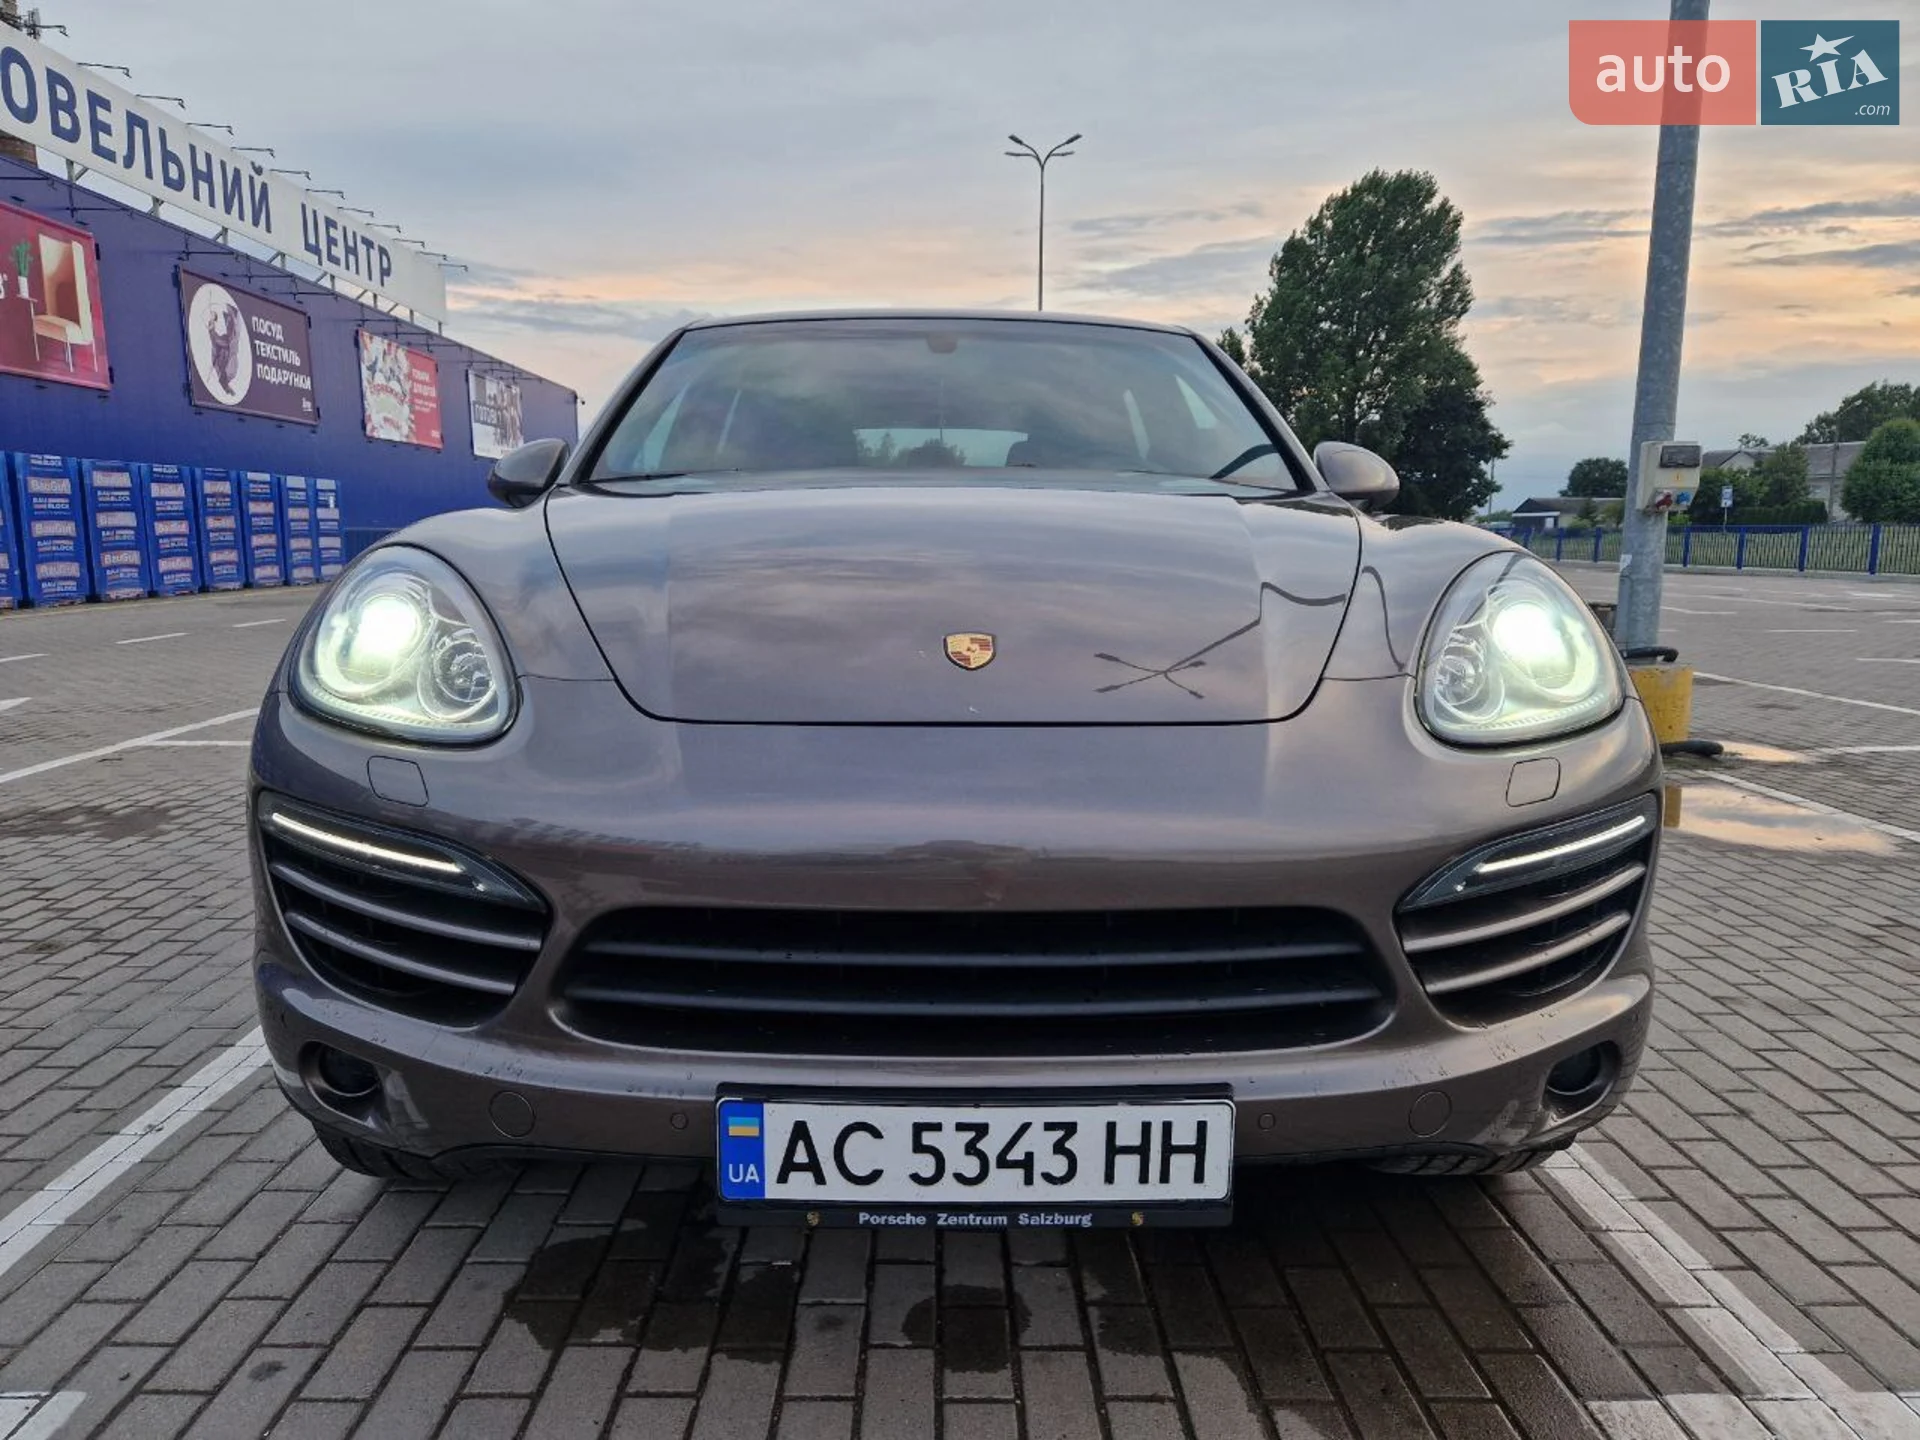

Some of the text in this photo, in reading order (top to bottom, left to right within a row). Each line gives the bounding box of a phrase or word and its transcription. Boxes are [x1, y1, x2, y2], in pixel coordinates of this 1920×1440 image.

[301, 203, 393, 289] ЦЕНТР
[252, 316, 284, 342] ПОСУД
[254, 340, 301, 366] ТЕКСТИЛЬ
[257, 363, 311, 390] ПОДАРУНКИ
[776, 1120, 1208, 1186] AC 5343 HH
[728, 1163, 760, 1184] UA
[858, 1211, 1093, 1228] Porsche Zentrum Salzburg
